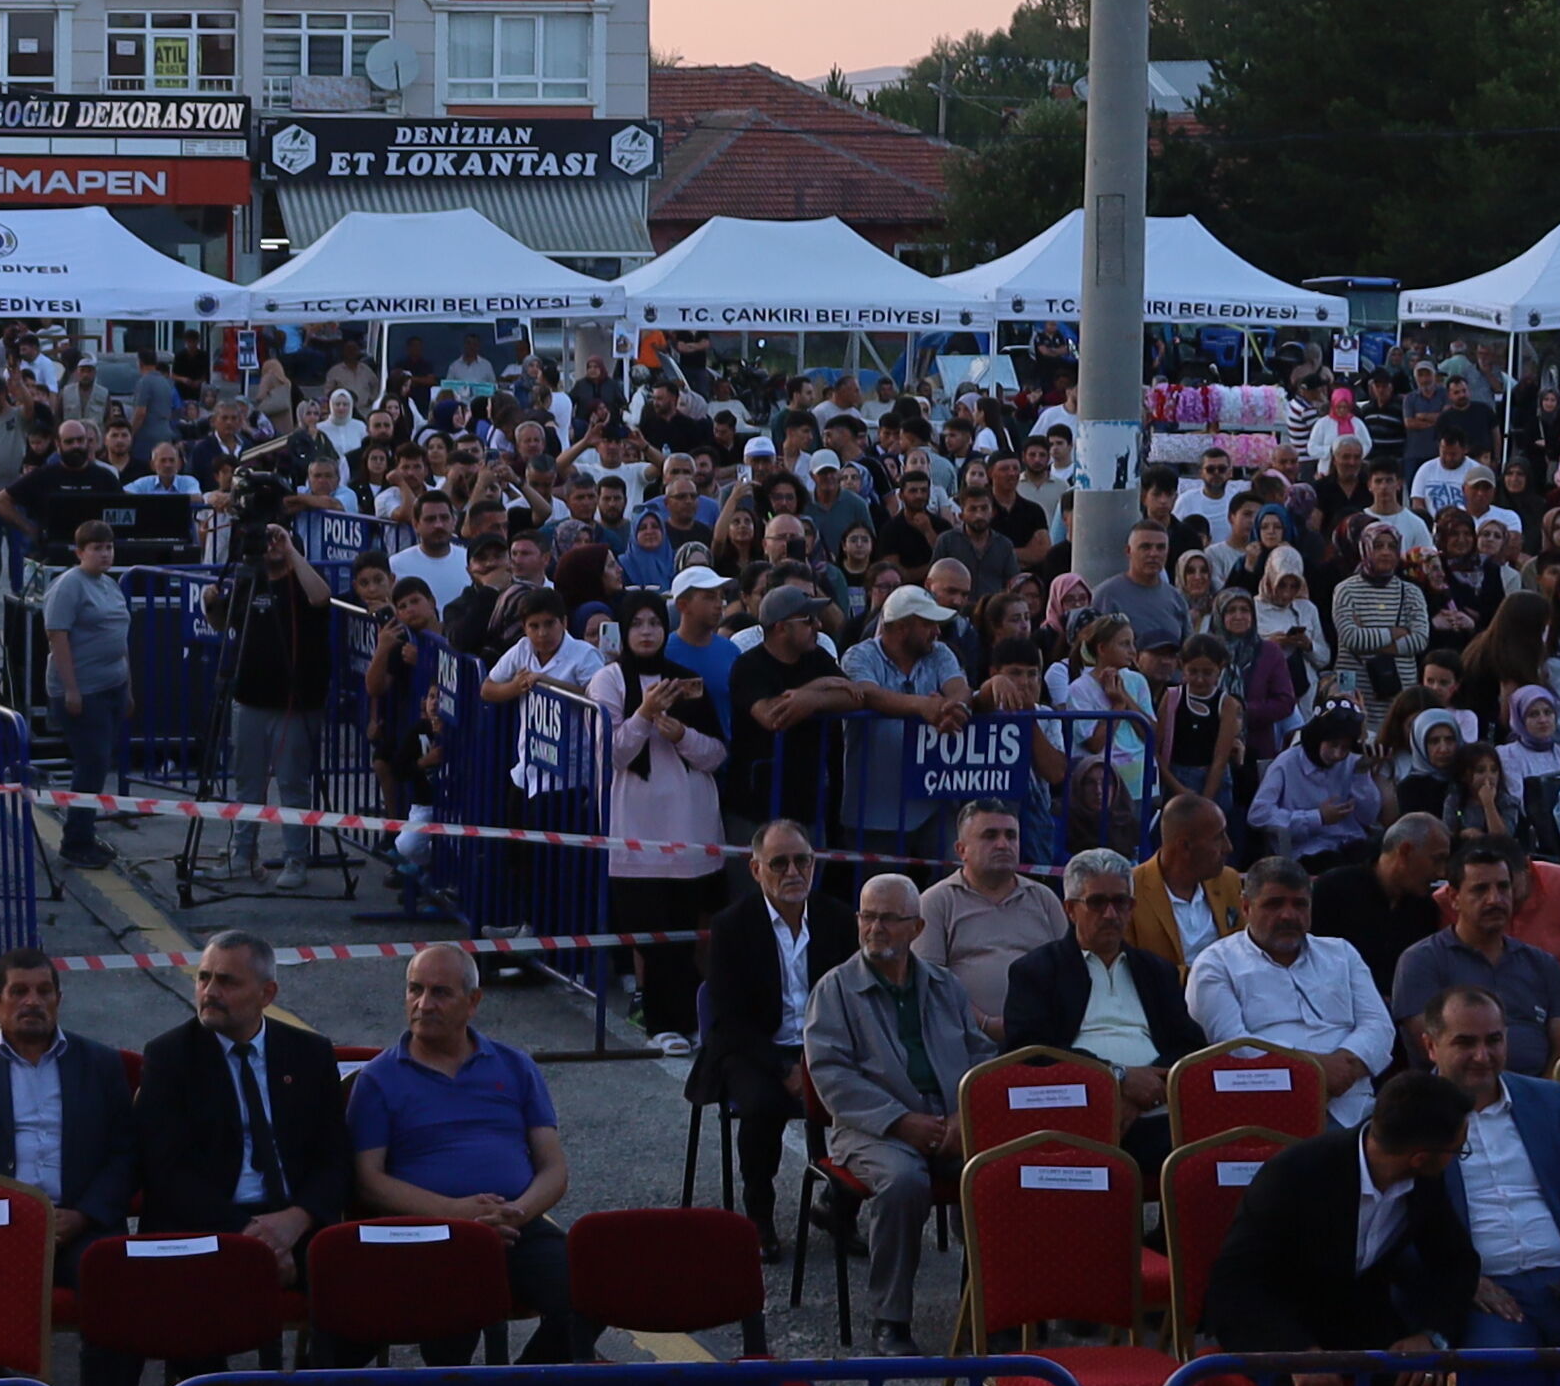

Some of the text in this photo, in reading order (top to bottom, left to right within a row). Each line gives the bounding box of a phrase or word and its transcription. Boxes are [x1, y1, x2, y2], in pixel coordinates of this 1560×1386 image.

[77, 101, 244, 130] DEKORASYON
[394, 121, 533, 145] DENİZHAN
[327, 152, 598, 177] ET LOKANTASI
[345, 298, 435, 315] ÇANKIRI
[679, 307, 714, 322] T.C.
[722, 307, 809, 327] ÇANKIRI
[1046, 298, 1080, 313] T.C.
[1179, 301, 1298, 320] BELEDİYESİ
[323, 516, 363, 548] POLİS
[527, 690, 562, 742] POLİS
[916, 722, 1021, 766] POLİS
[924, 769, 1010, 796] ÇANKIRI
